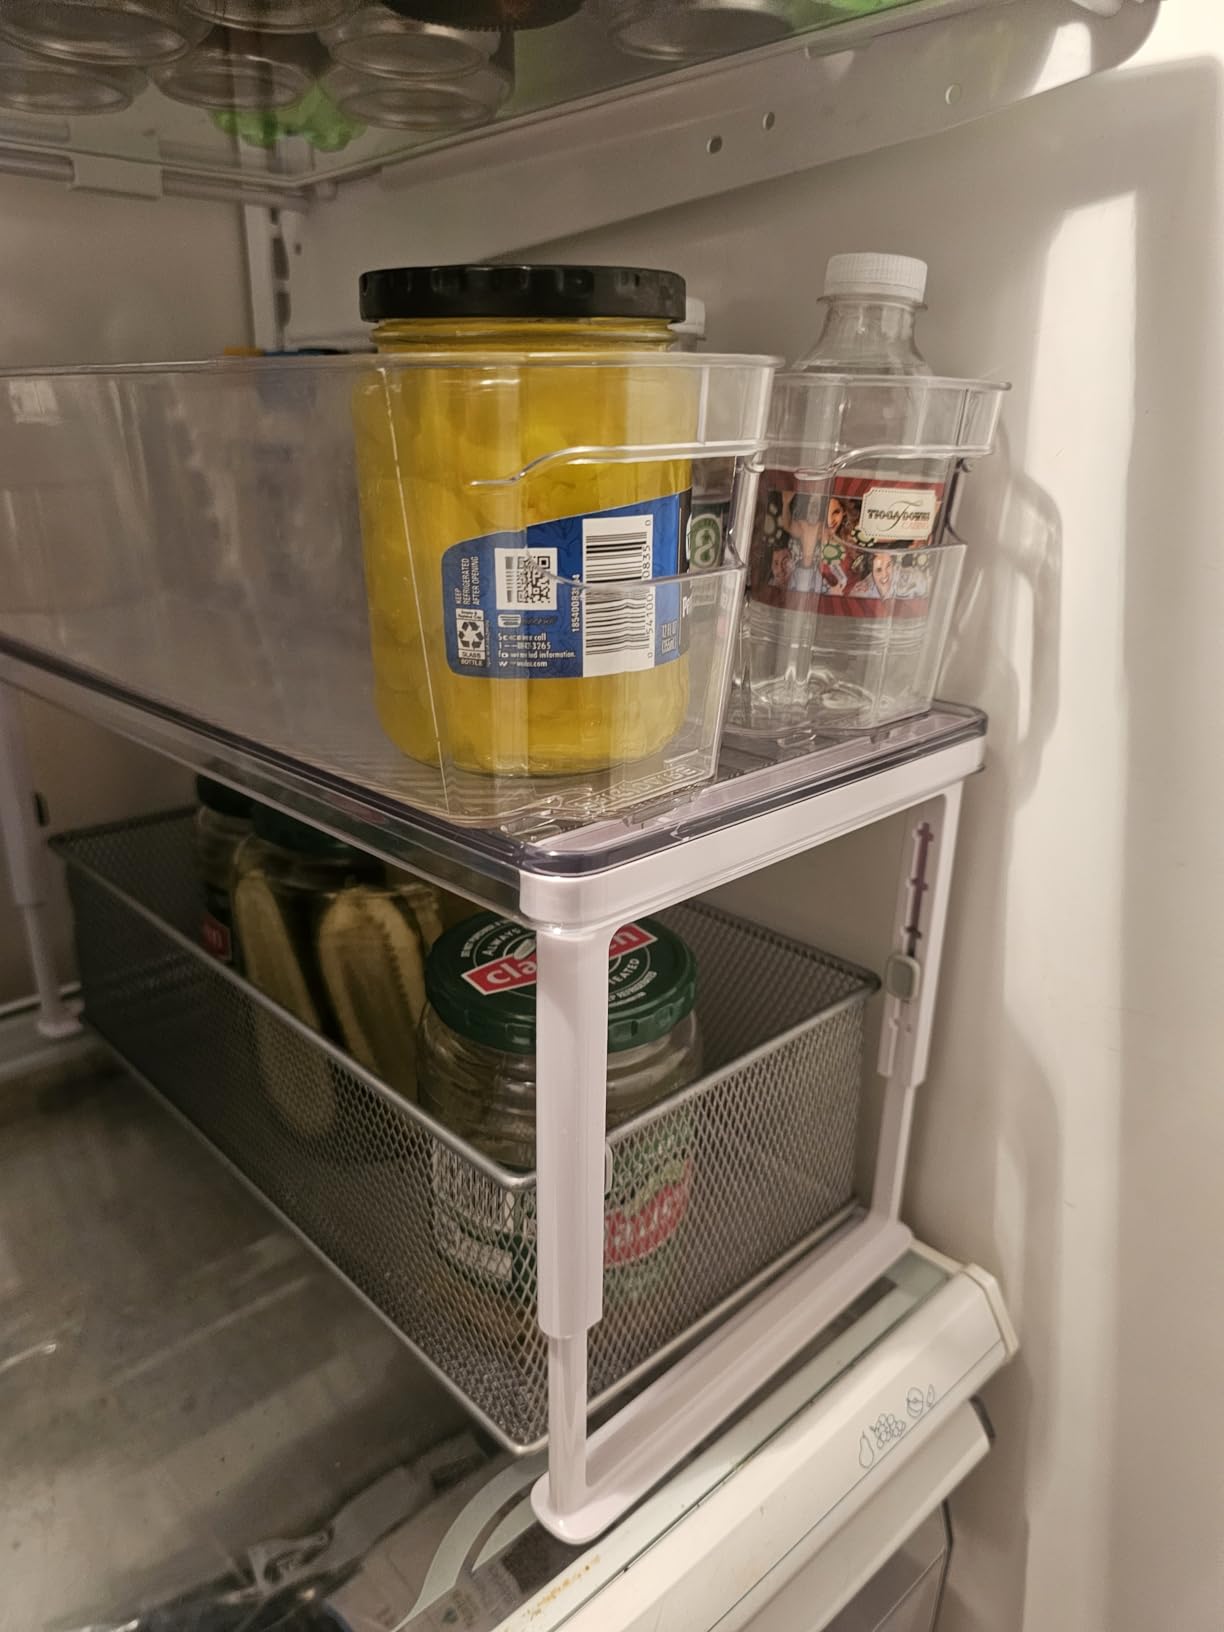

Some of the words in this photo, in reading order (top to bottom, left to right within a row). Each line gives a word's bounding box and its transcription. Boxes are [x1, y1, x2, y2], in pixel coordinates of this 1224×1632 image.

[471, 556, 480, 585] OPENING
[460, 558, 470, 605] REFRIGERATED
[454, 587, 462, 605] KEEP
[471, 585, 480, 606] AFTER
[534, 632, 547, 641] call
[460, 658, 482, 667] BOTTLE
[461, 651, 481, 659] GLASS
[481, 927, 521, 957] ALWAYS
